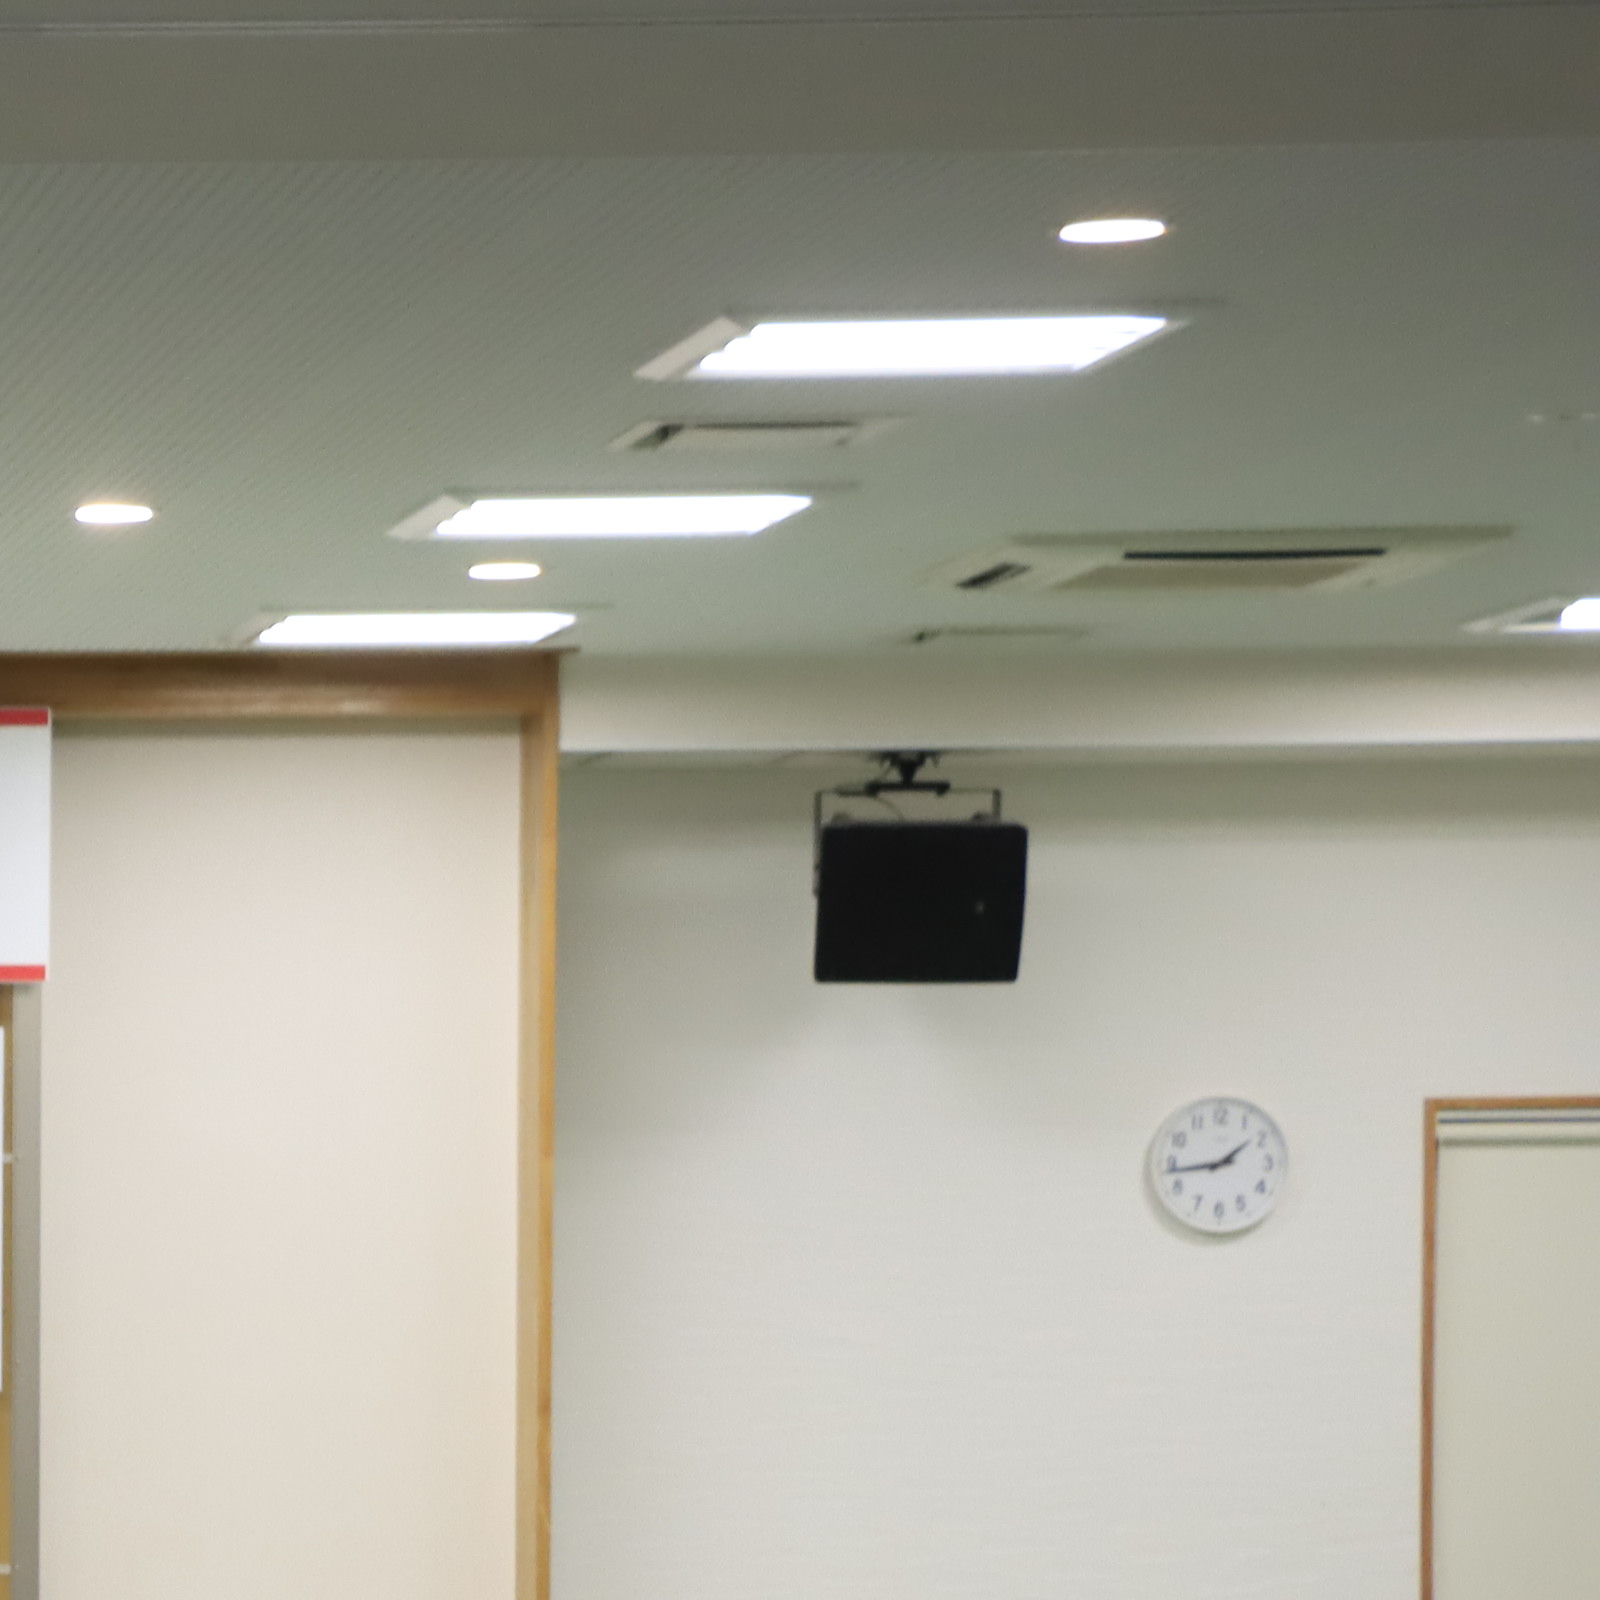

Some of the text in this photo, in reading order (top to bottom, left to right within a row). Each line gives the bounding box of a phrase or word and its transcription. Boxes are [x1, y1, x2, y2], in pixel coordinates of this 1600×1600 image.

[1191, 1114, 1203, 1130] 11
[1213, 1107, 1228, 1125] 12
[1172, 1131, 1187, 1148] 10
[1257, 1130, 1267, 1148] 2
[1264, 1152, 1274, 1171] 3
[1255, 1178, 1266, 1194] 4
[1192, 1194, 1203, 1211] 7
[1213, 1200, 1225, 1217] 6
